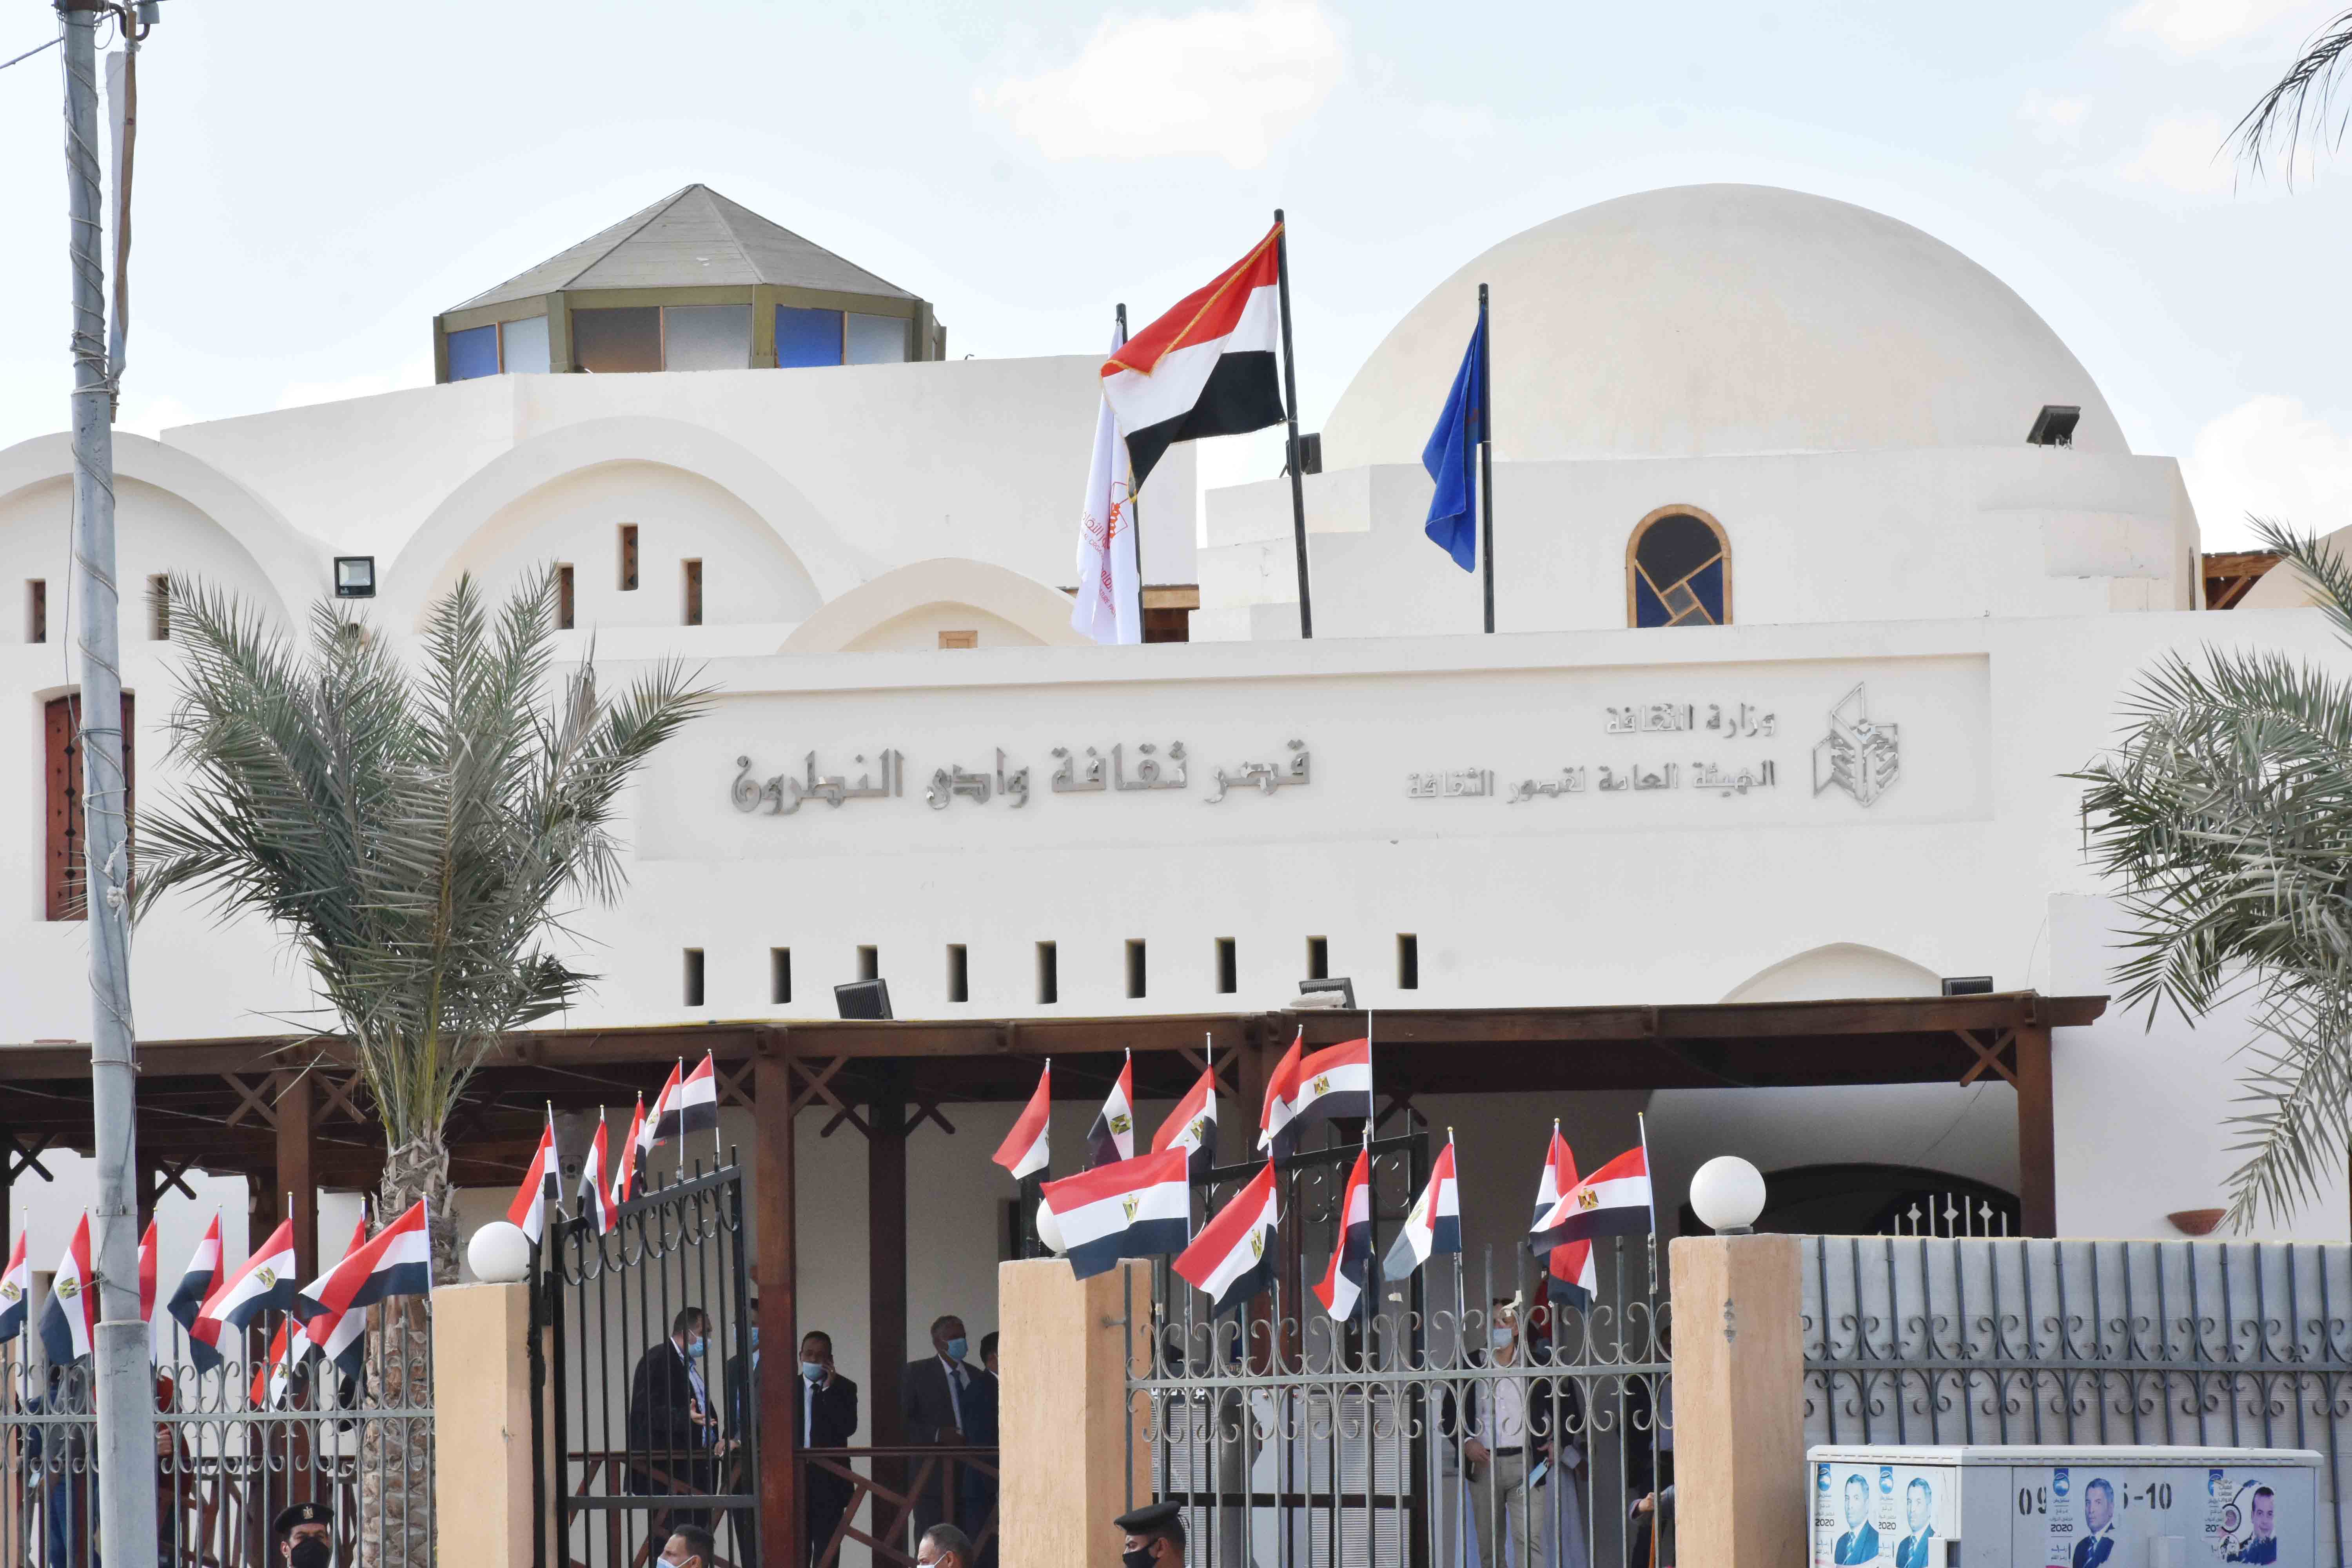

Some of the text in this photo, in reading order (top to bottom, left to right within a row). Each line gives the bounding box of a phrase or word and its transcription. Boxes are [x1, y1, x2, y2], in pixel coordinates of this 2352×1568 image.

[1606, 702, 1775, 739] وزارة الثقافة
[731, 748, 904, 816] النطرون
[1051, 740, 1187, 793] ثقافة
[1204, 739, 1310, 804] قصر
[1408, 760, 1775, 804] الهيئة العامة لقصور الثقافة
